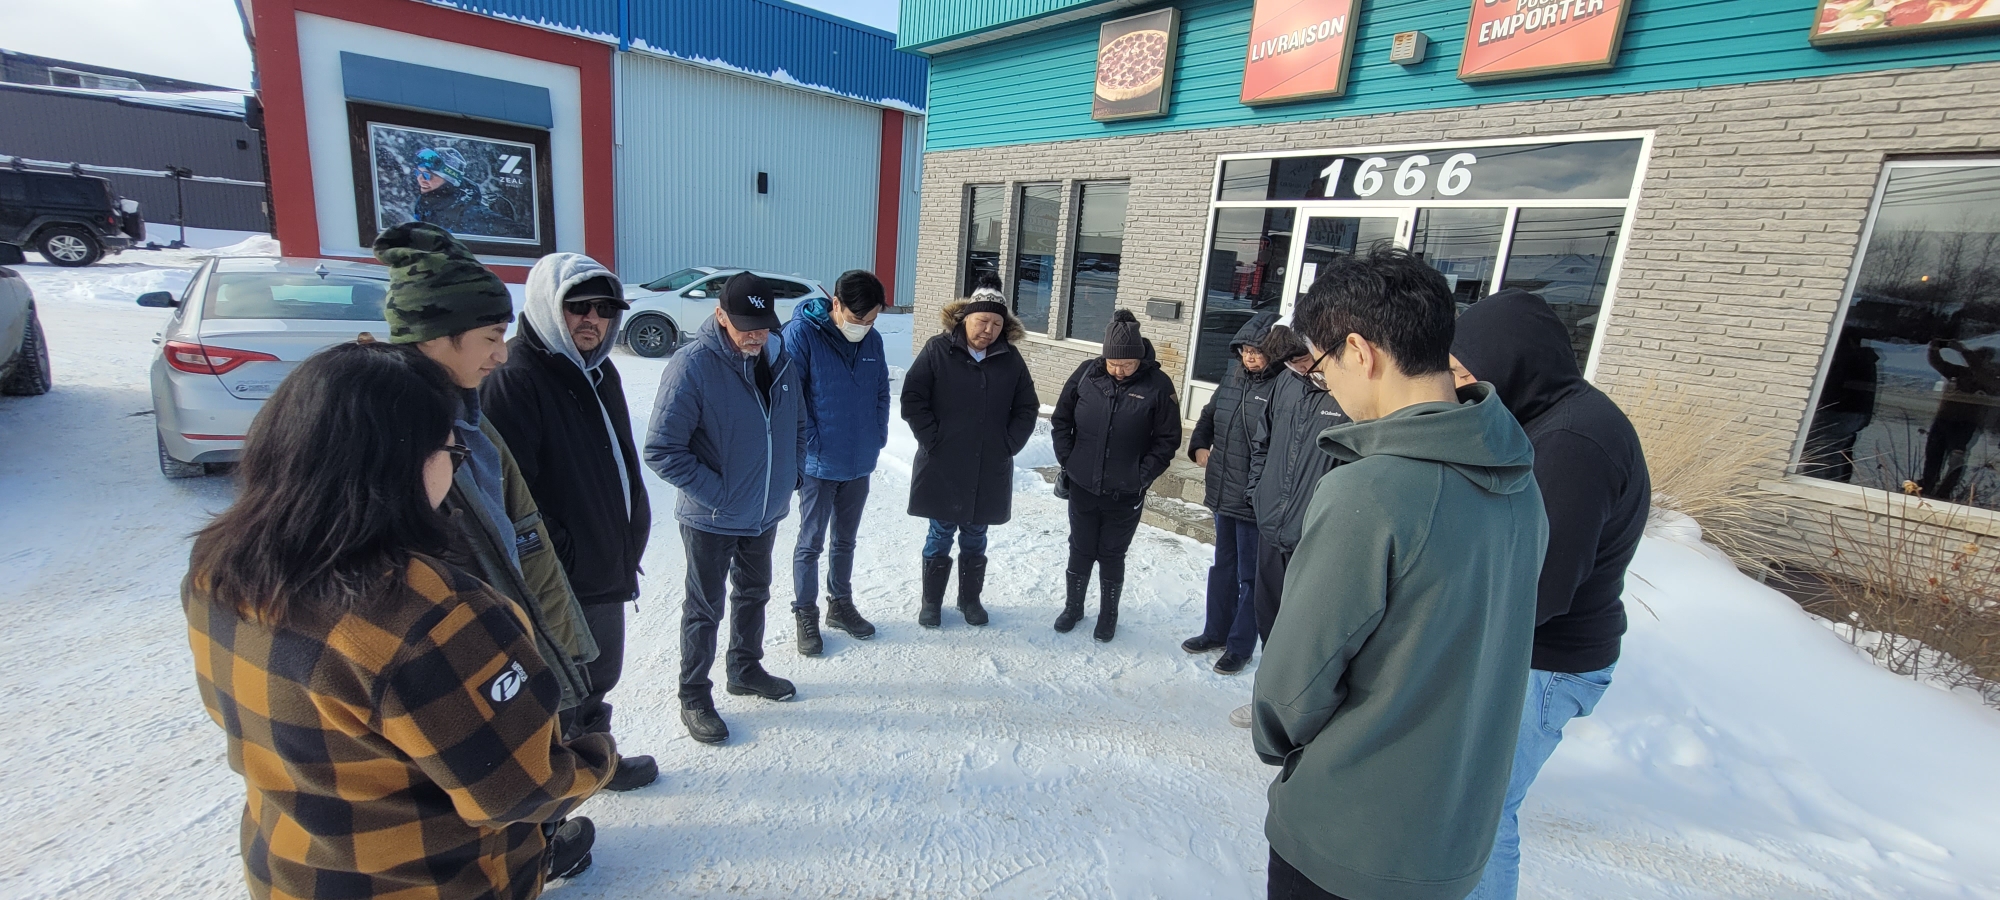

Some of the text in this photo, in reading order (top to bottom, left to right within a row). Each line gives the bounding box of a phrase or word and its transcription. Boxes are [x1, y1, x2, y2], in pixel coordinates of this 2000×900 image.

[1251, 14, 1346, 62] LIVRAISON
[1478, 0, 1604, 43] EMPORTER
[499, 176, 524, 185] ZEAL
[1319, 152, 1478, 198] 1666
